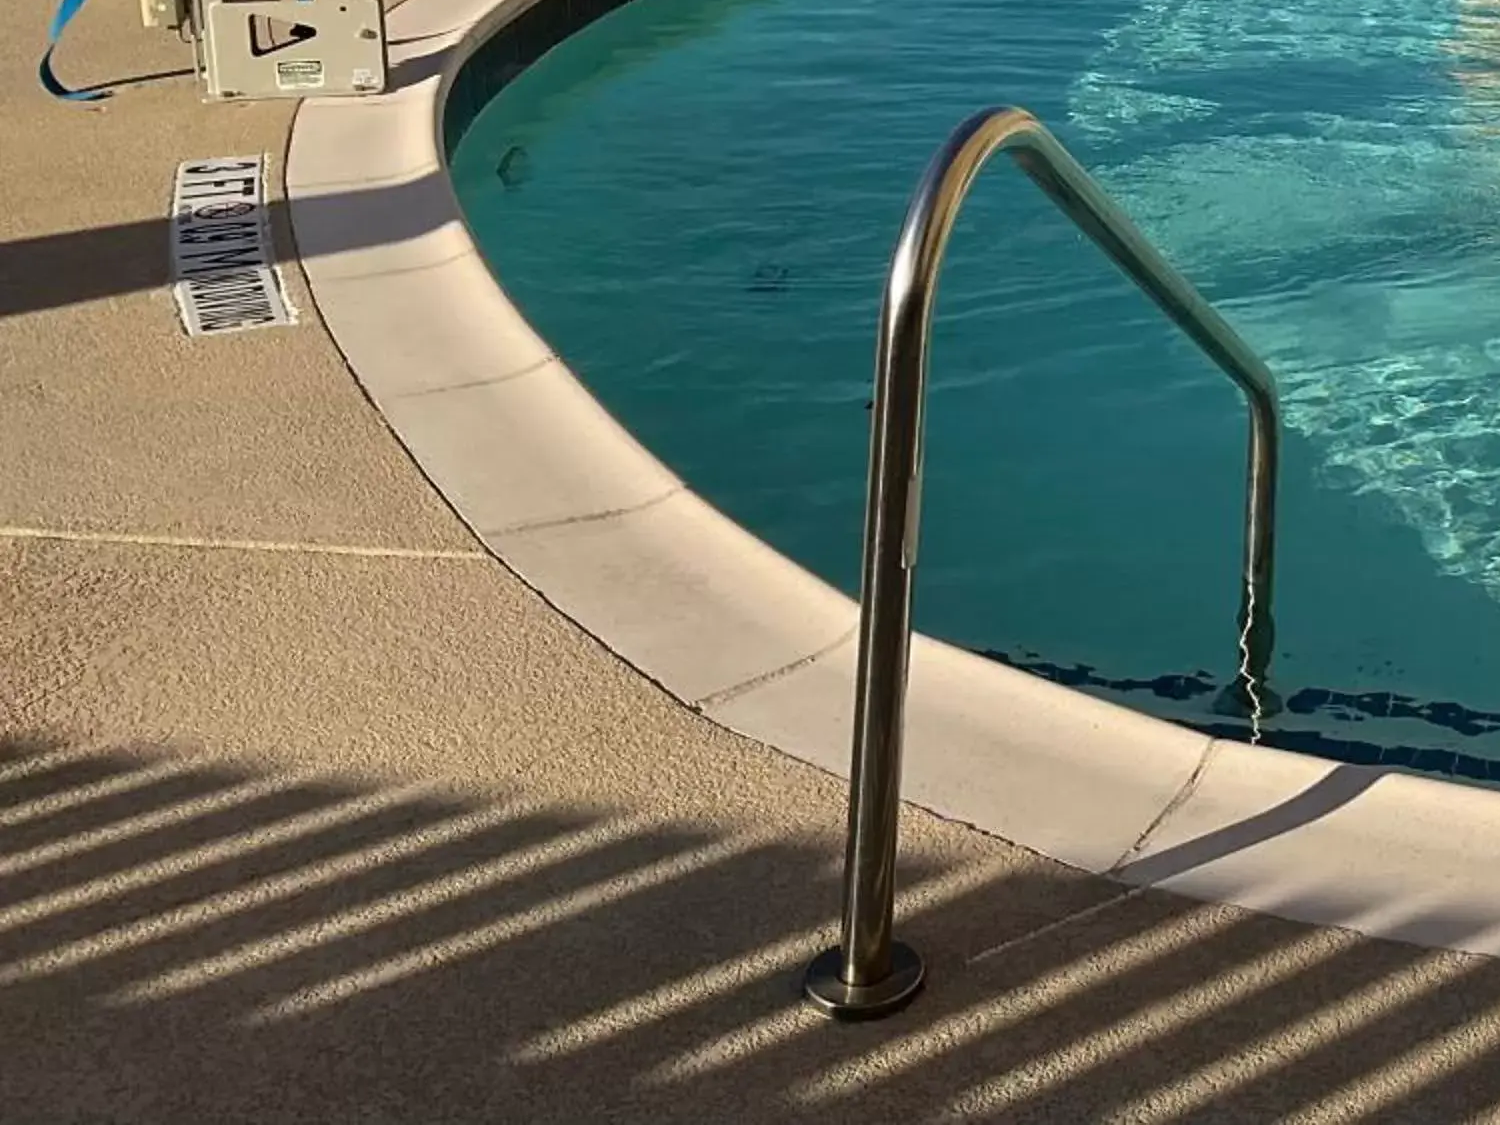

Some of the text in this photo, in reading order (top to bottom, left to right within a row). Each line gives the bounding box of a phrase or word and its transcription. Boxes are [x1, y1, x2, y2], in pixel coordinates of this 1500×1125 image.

[185, 162, 257, 173] 3
[182, 176, 255, 199] FT
[181, 246, 263, 274] M
